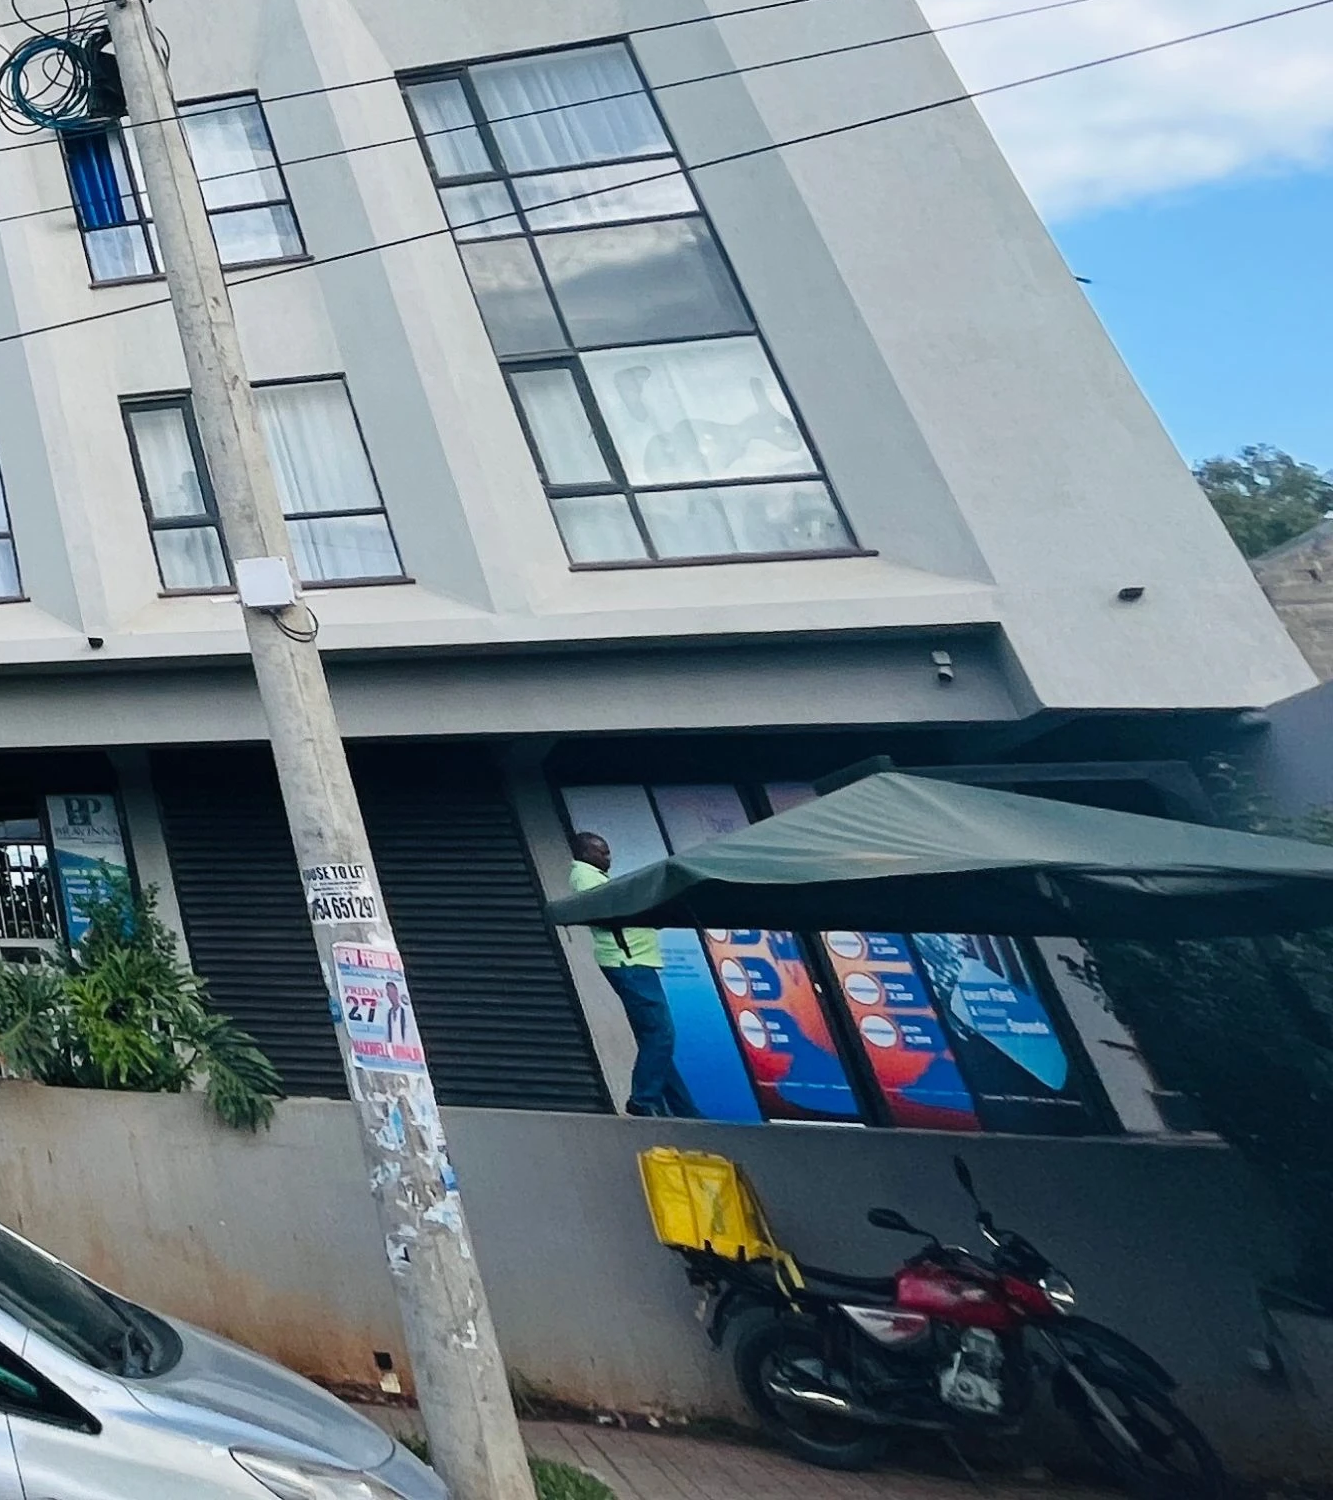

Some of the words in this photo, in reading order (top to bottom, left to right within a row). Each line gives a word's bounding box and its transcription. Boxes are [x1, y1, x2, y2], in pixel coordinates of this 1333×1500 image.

[330, 865, 347, 879] TO
[348, 864, 367, 879] LET
[331, 896, 357, 920] 651
[344, 985, 384, 998] FRIDAY
[346, 995, 377, 1023] 27
